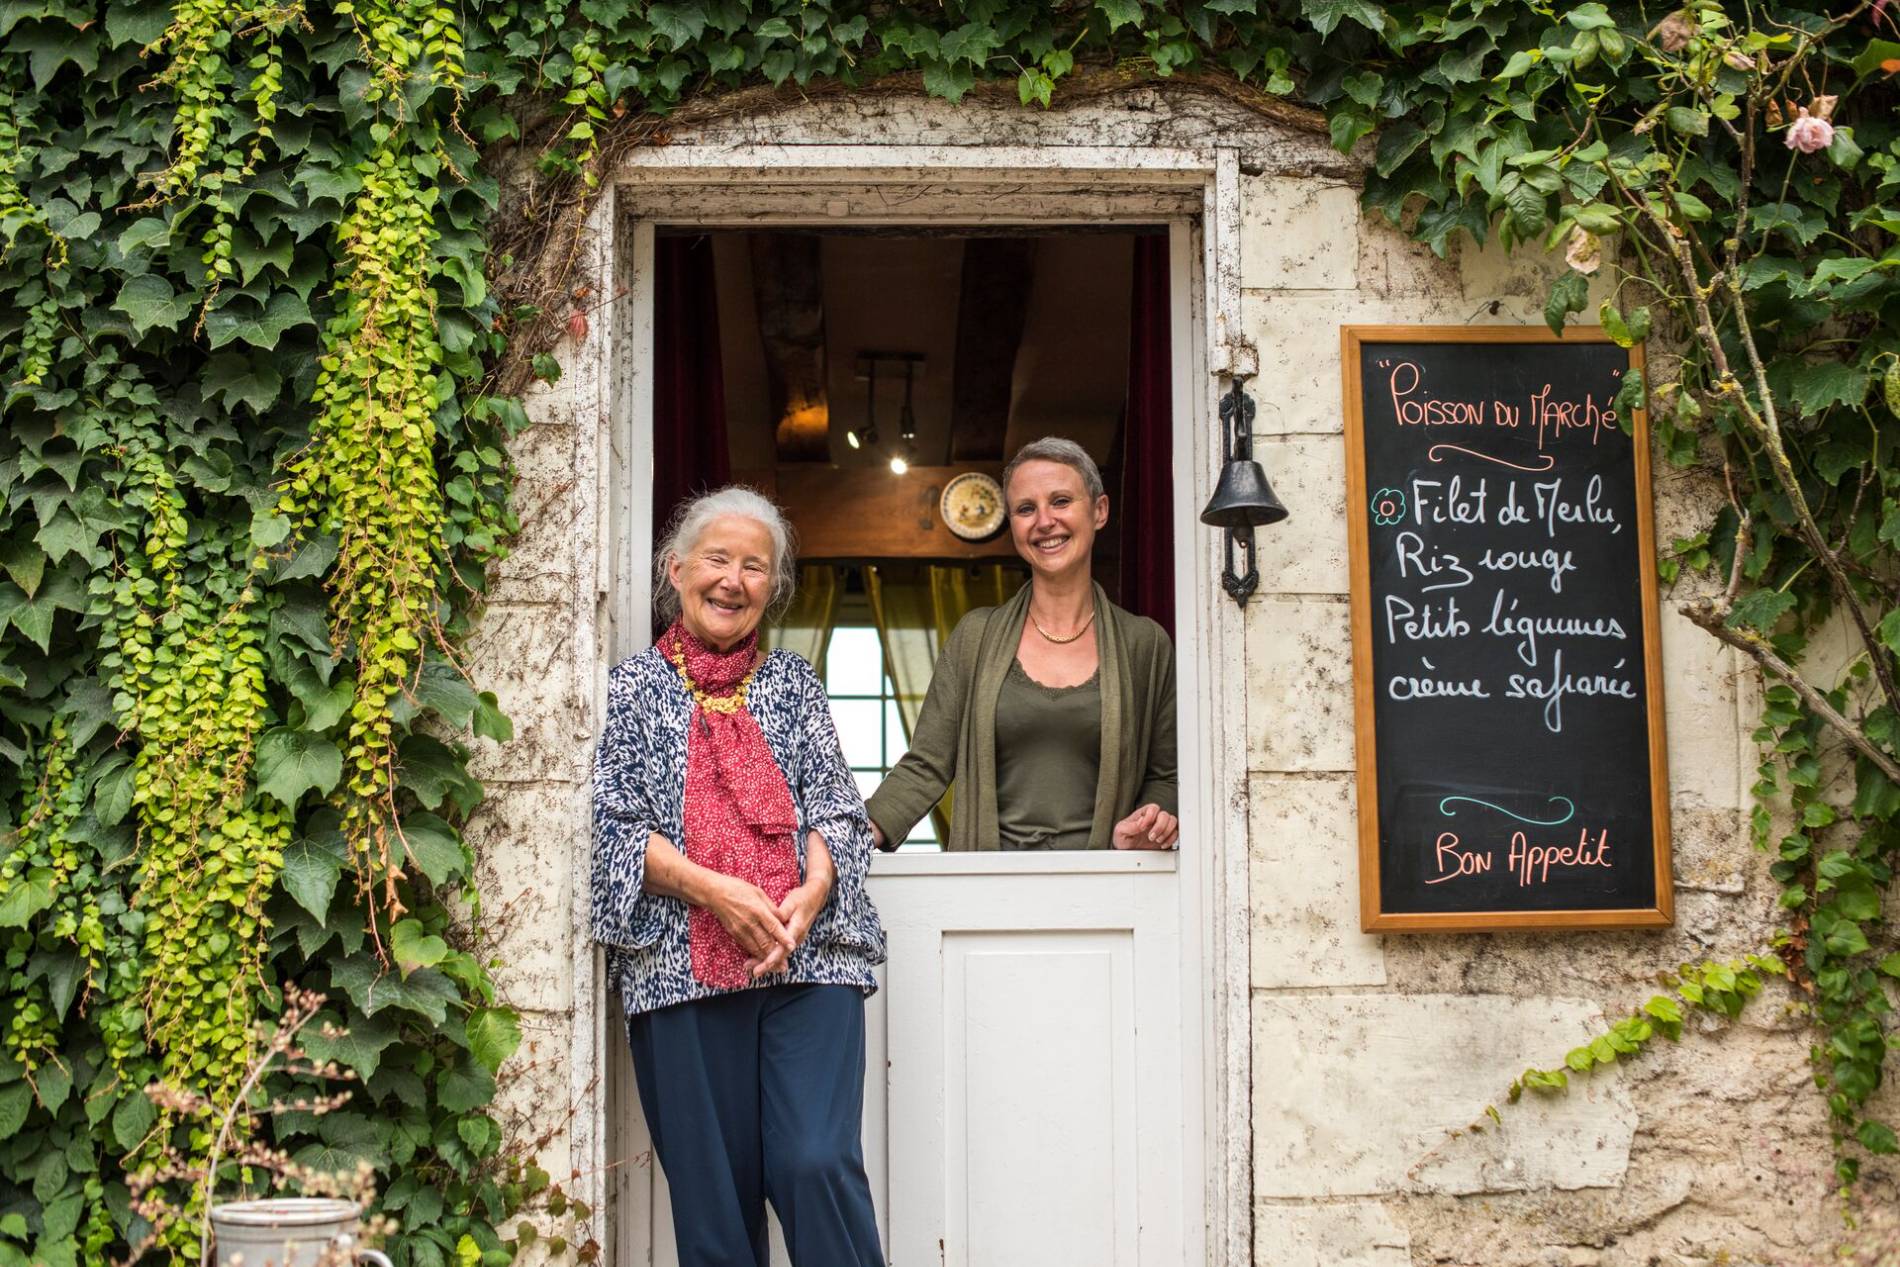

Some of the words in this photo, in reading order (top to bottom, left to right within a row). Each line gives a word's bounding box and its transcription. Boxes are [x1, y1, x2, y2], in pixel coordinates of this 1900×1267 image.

[1413, 475, 1488, 525] Filet
[1498, 481, 1531, 525] de
[1396, 531, 1474, 592] Riz
[1478, 549, 1577, 593] rouge
[1385, 594, 1470, 644] Petits
[1481, 588, 1627, 666] légumes
[1388, 656, 1490, 700] crème
[1509, 828, 1612, 887] Appetit
